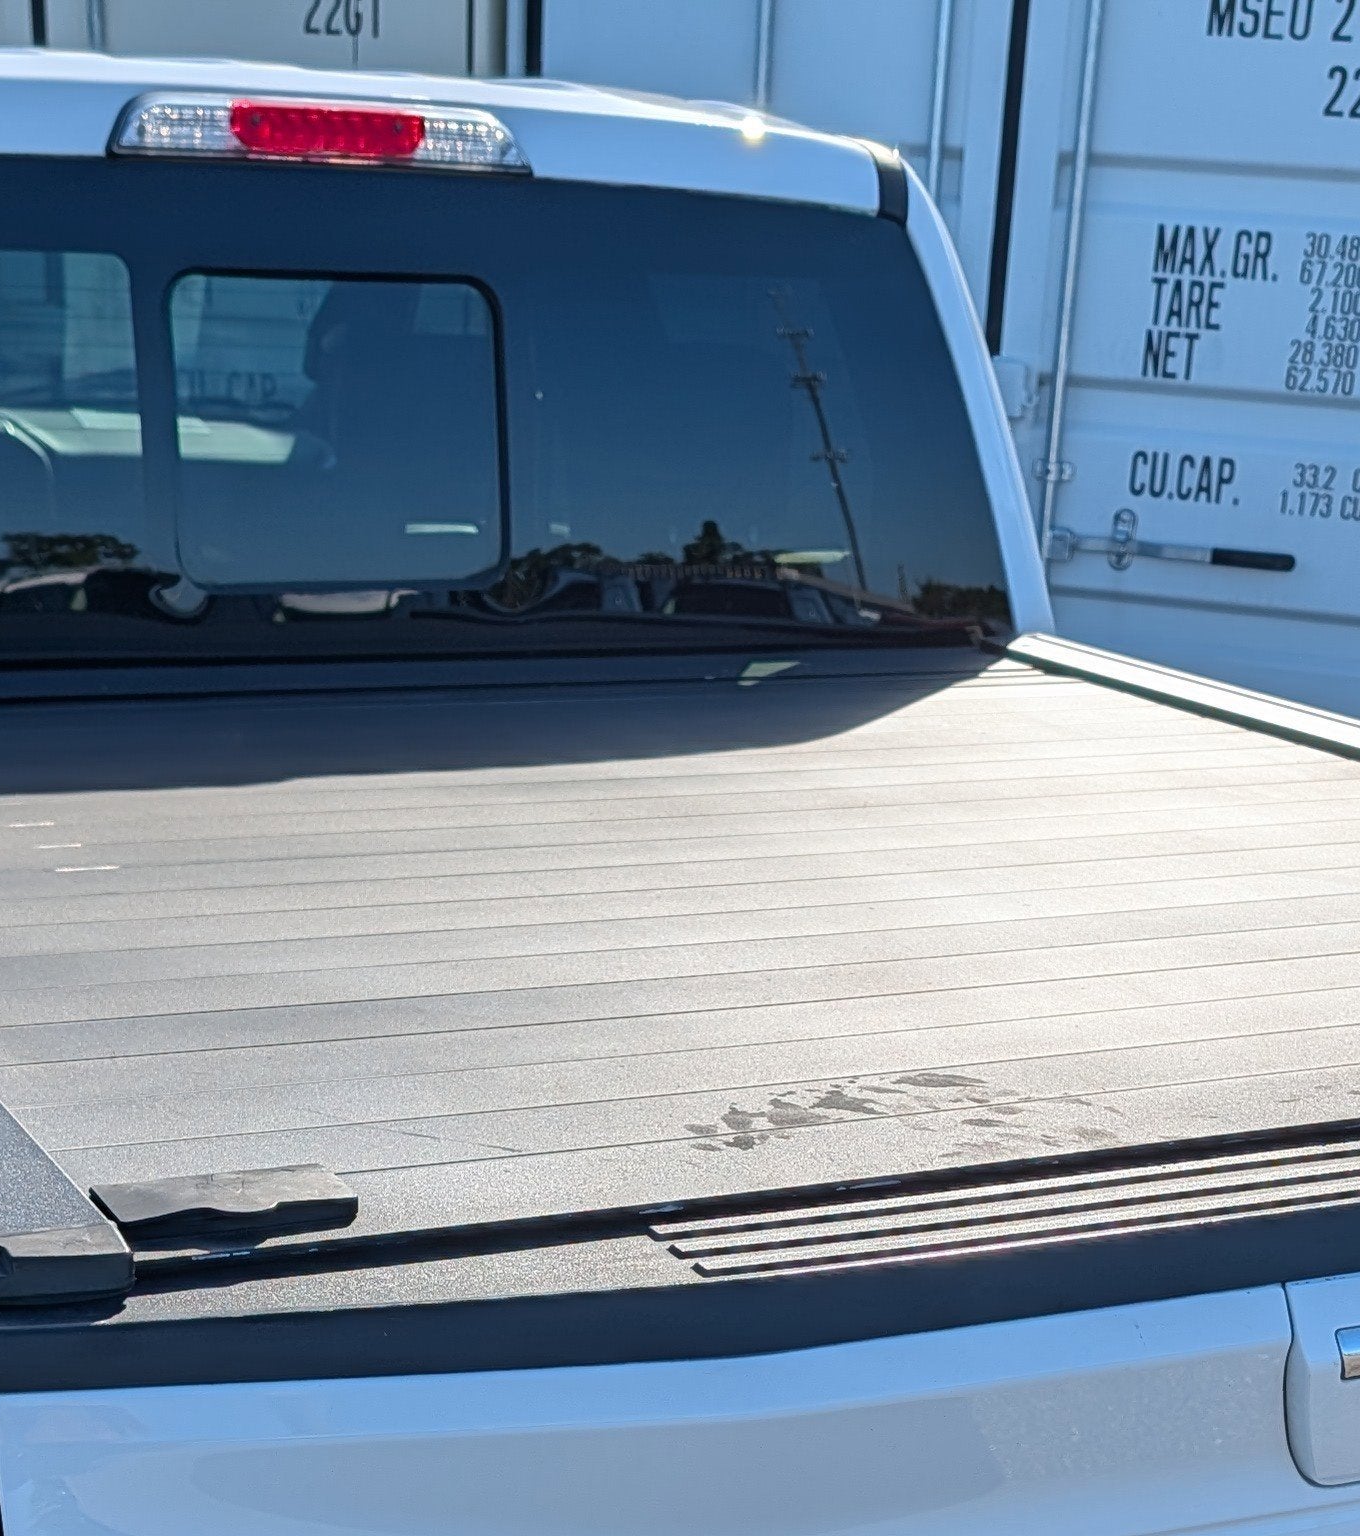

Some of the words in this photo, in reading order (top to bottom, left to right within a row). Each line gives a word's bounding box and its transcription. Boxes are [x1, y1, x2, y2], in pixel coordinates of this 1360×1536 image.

[303, 0, 381, 38] 22G1
[1206, 0, 1314, 40] MSEU
[1152, 223, 1279, 282] MAX.GR.
[1151, 277, 1226, 331] TARE
[1141, 328, 1200, 380] NET
[1284, 366, 1355, 397] 62.570
[1279, 489, 1333, 519] 1.173
